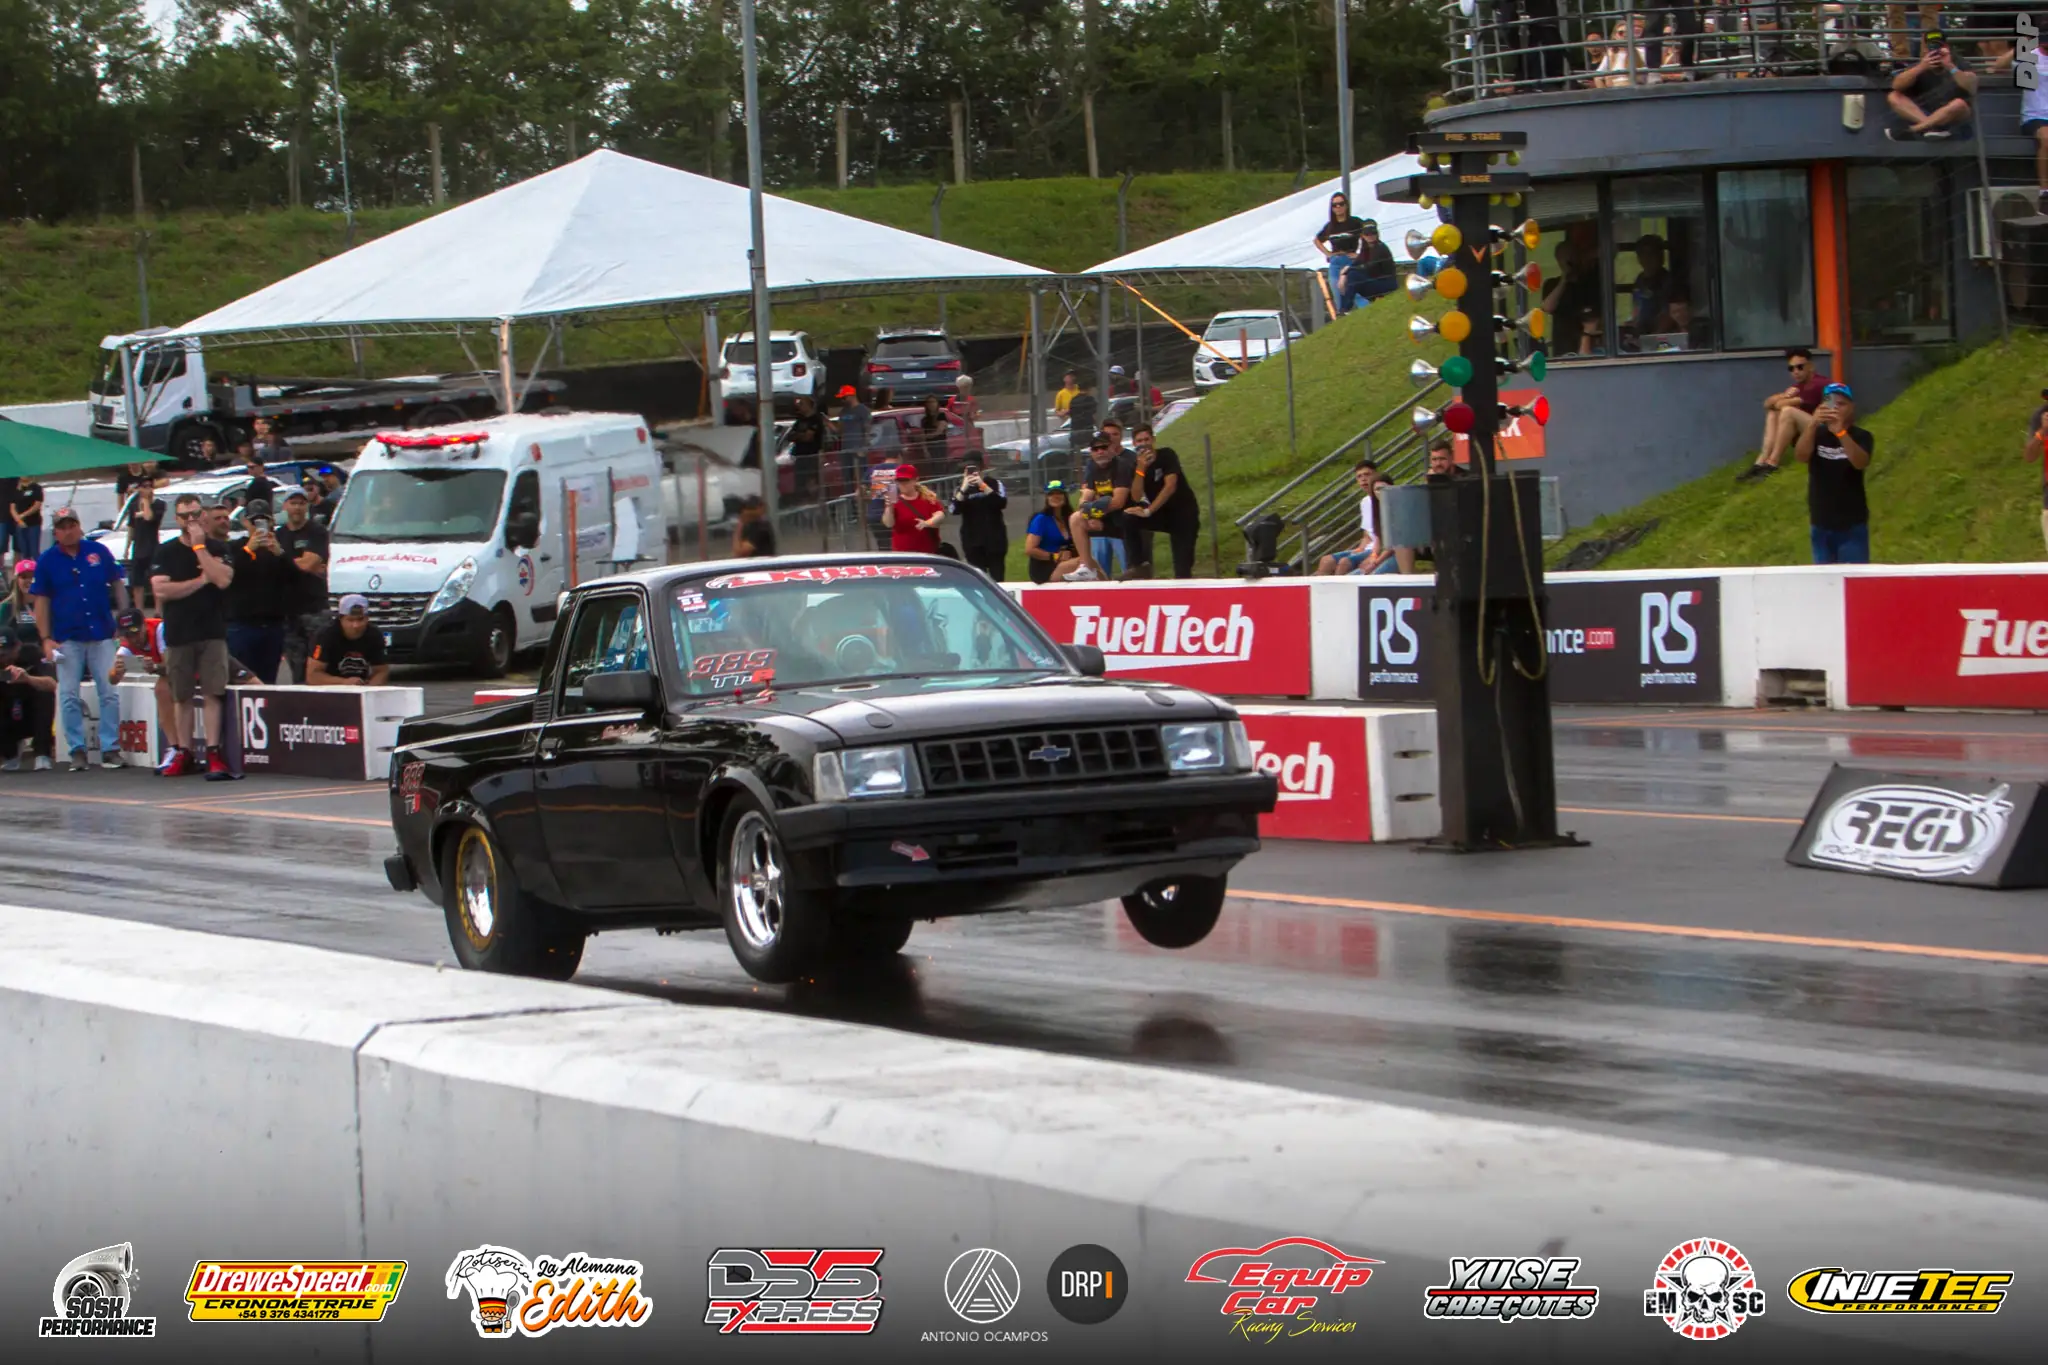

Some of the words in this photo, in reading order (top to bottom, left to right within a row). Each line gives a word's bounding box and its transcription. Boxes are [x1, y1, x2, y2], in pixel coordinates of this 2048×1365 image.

[1471, 133, 1501, 141] STAGE
[1460, 175, 1491, 183] STAGE
[1070, 604, 1254, 661] FuelTech
[1369, 597, 1421, 664] RS
[1640, 590, 1701, 664] RS
[1959, 608, 2048, 656] Fue
[1369, 669, 1419, 685] performance
[1640, 669, 1697, 685] performance
[241, 697, 268, 749] RS
